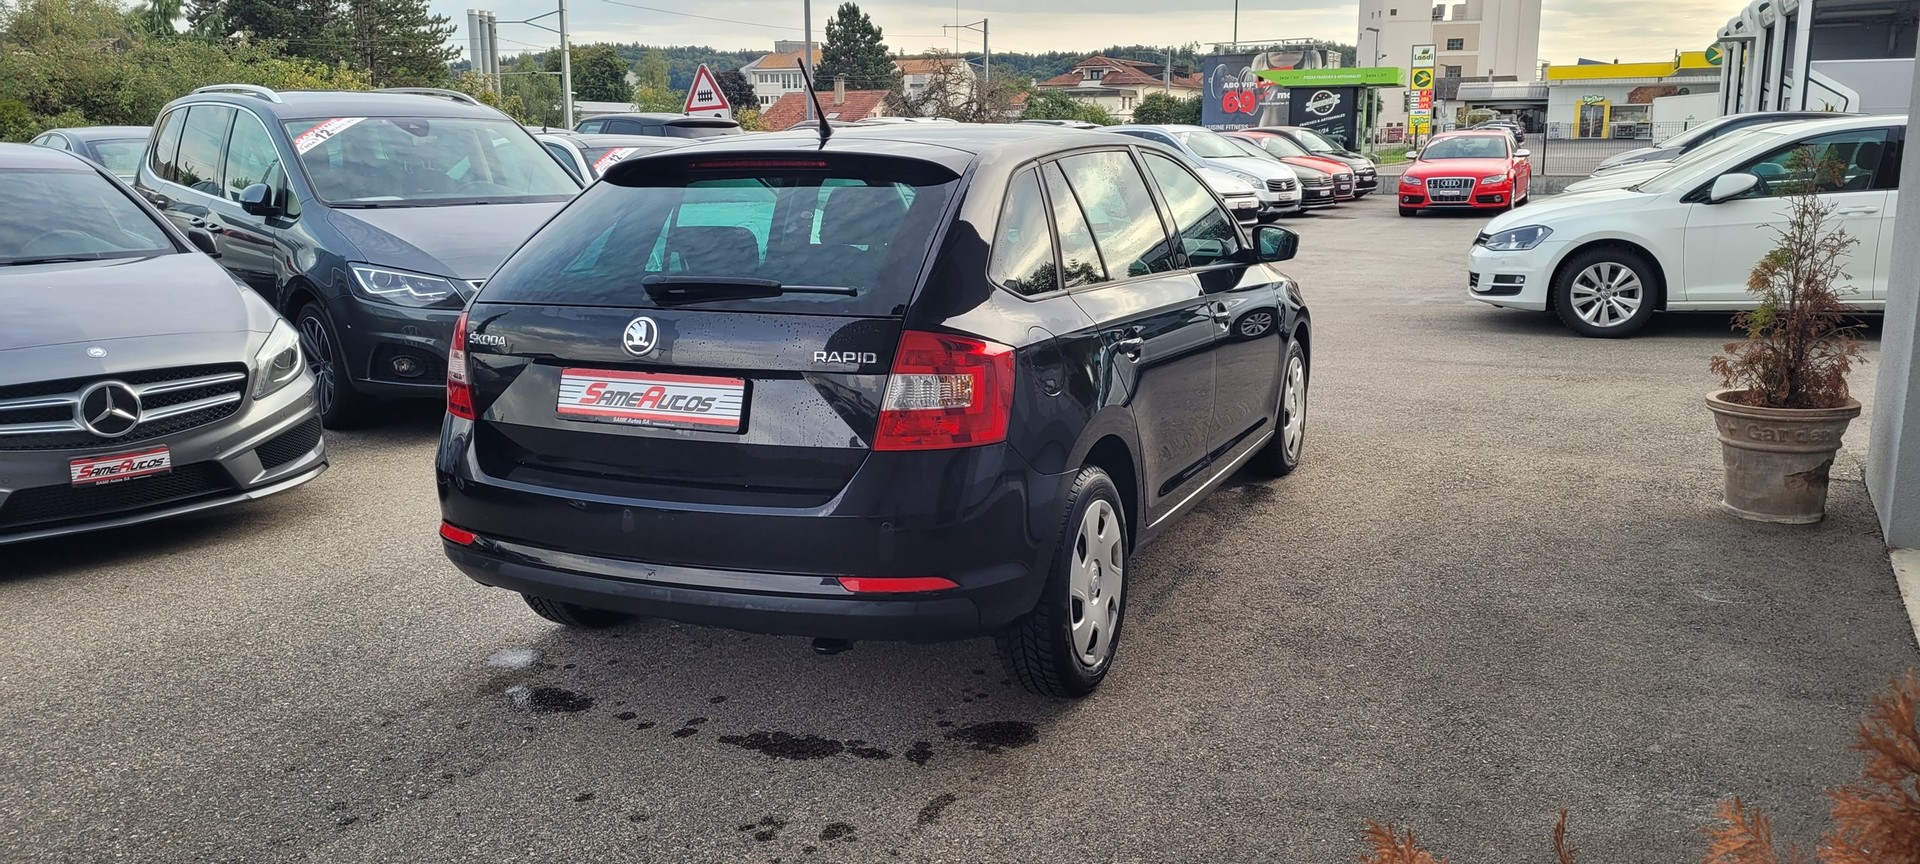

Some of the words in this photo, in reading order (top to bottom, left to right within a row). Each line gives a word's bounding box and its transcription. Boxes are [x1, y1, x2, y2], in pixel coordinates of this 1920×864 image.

[315, 129, 335, 140] 12
[610, 154, 622, 162] 12
[813, 351, 877, 364] RAPID
